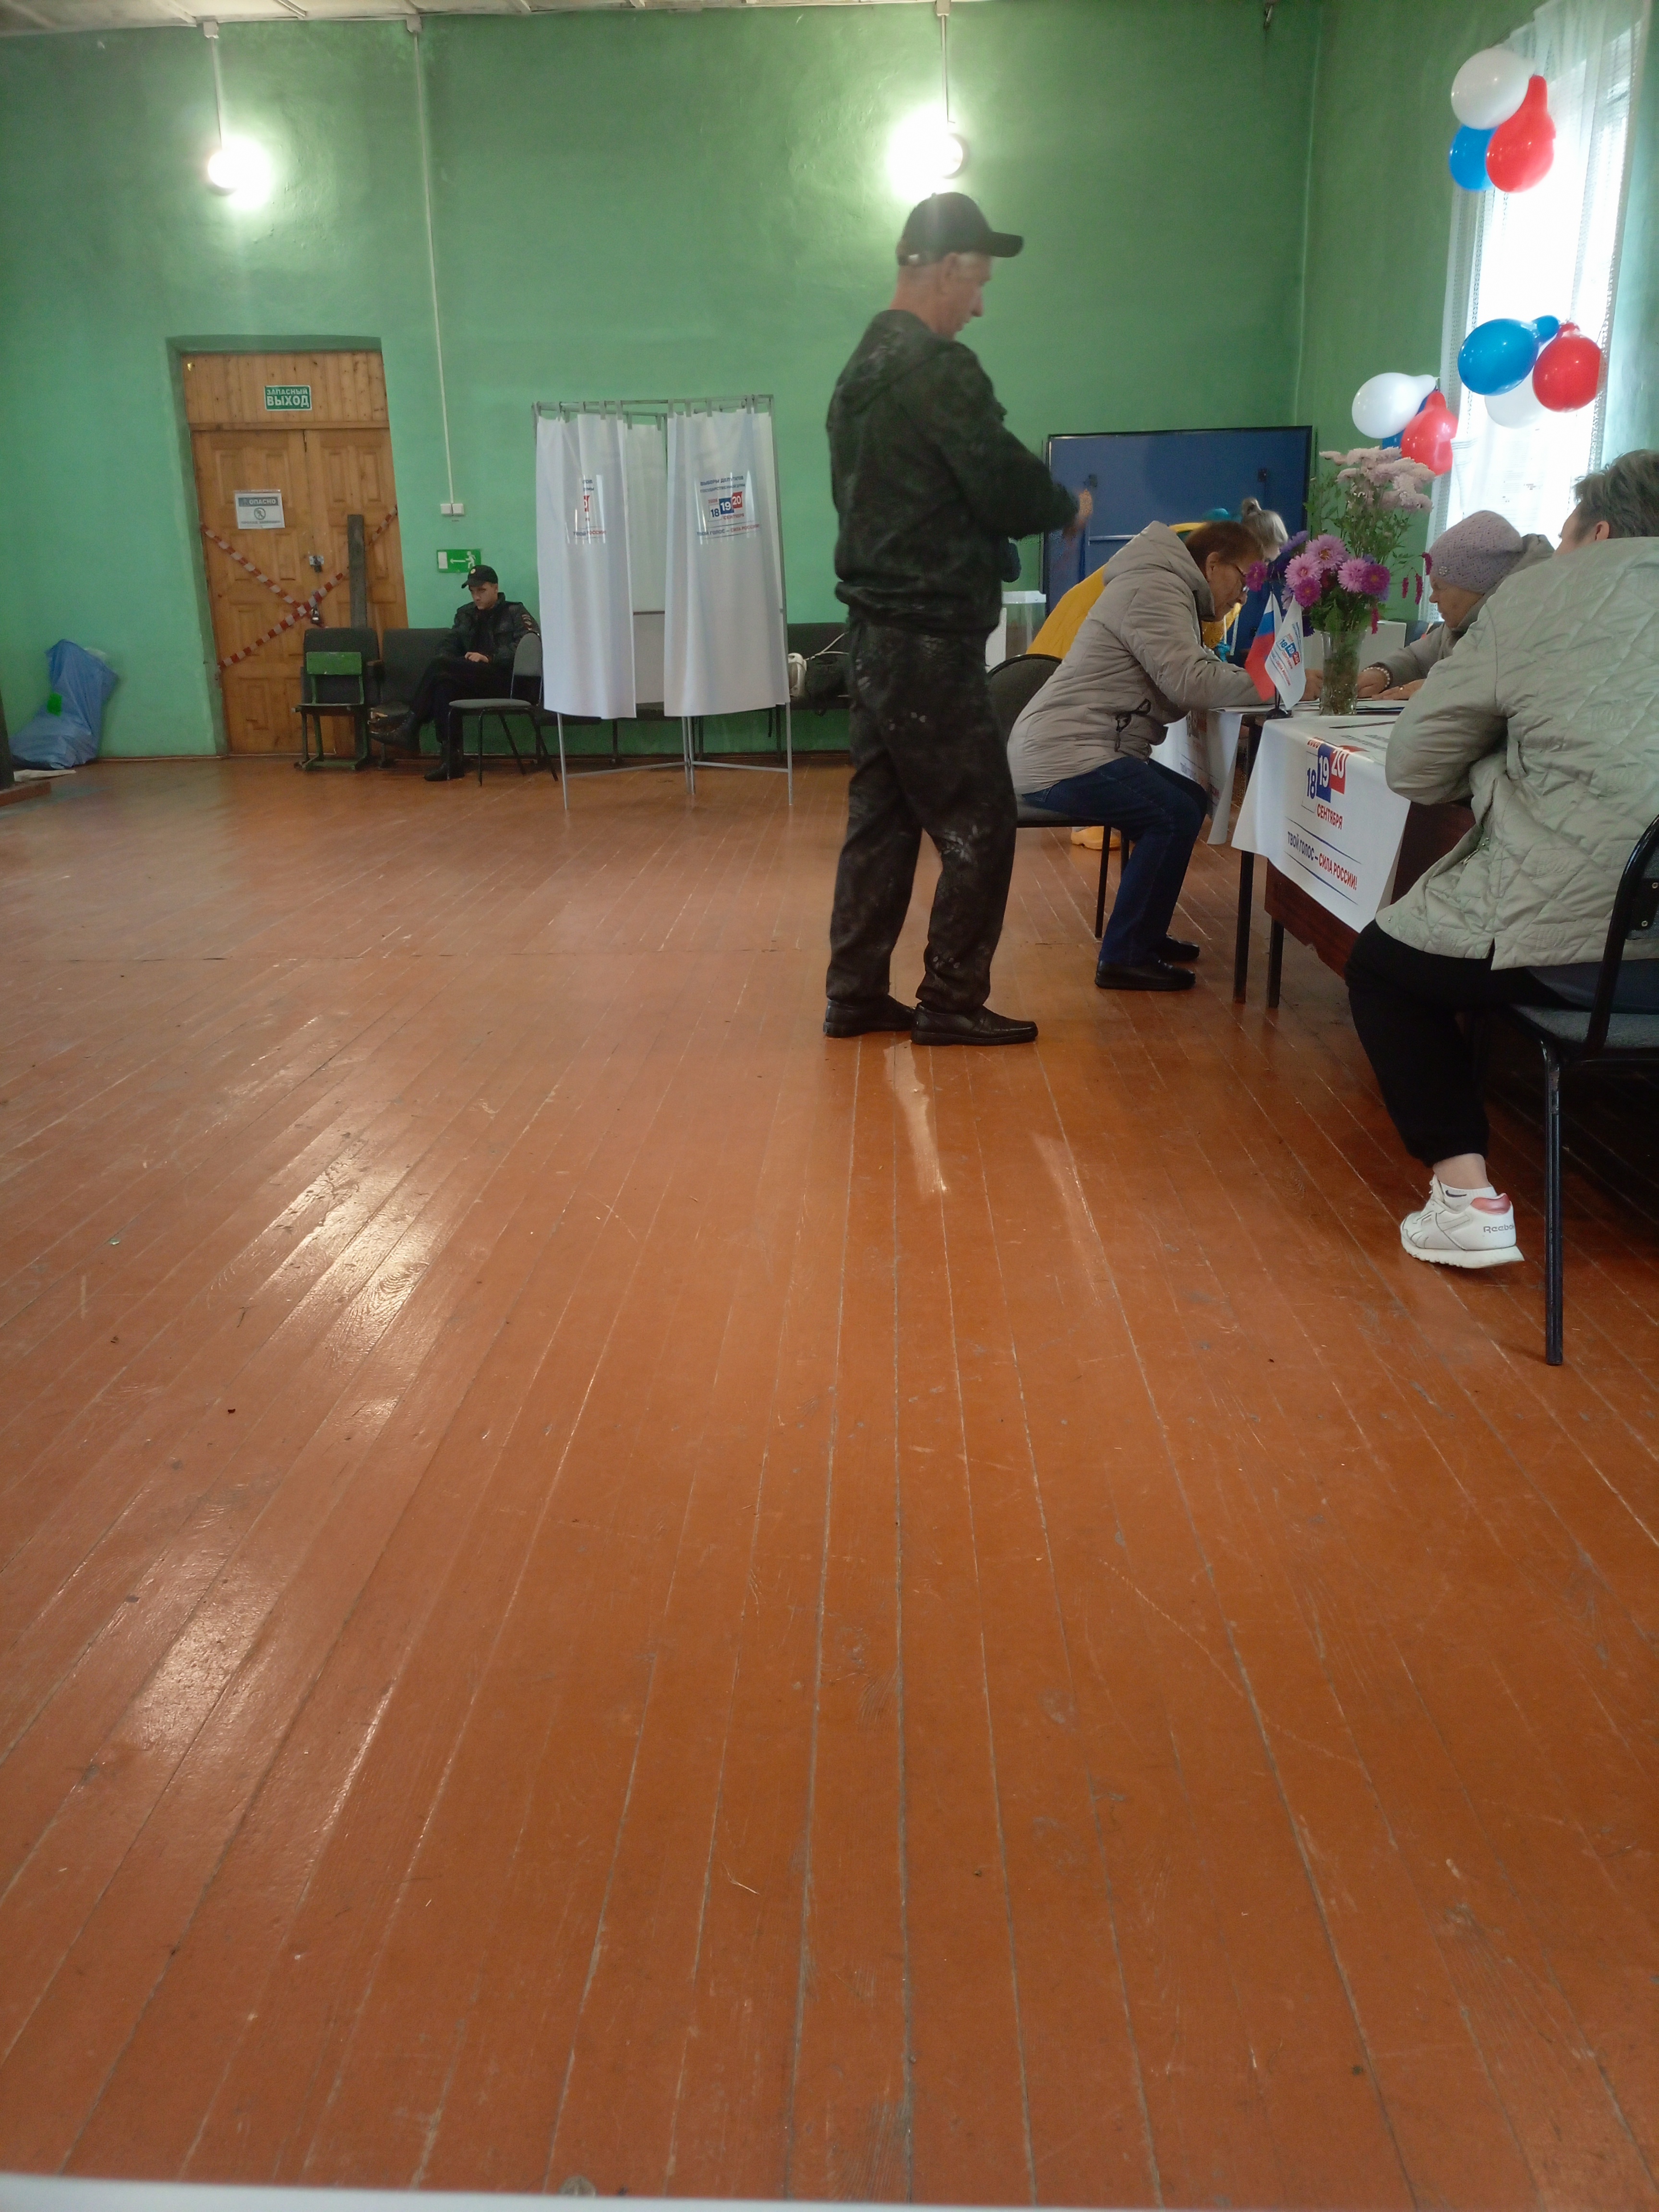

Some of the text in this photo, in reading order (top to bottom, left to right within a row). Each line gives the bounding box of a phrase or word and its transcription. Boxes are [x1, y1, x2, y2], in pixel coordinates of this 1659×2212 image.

[266, 395, 310, 408] ВЫХОД
[710, 496, 741, 517] 18 19 20
[1280, 639, 1287, 648] 18
[1287, 645, 1295, 654] 19
[1293, 653, 1299, 662] 20
[1307, 748, 1347, 799] 18 19 20
[1317, 803, 1343, 830] СЕНТЯБРЯ
[1287, 831, 1299, 851] ТВОЙ
[1299, 839, 1315, 861] ГОЛОС
[1319, 853, 1333, 874] СИЛА
[1333, 862, 1358, 891] РОССИИ!
